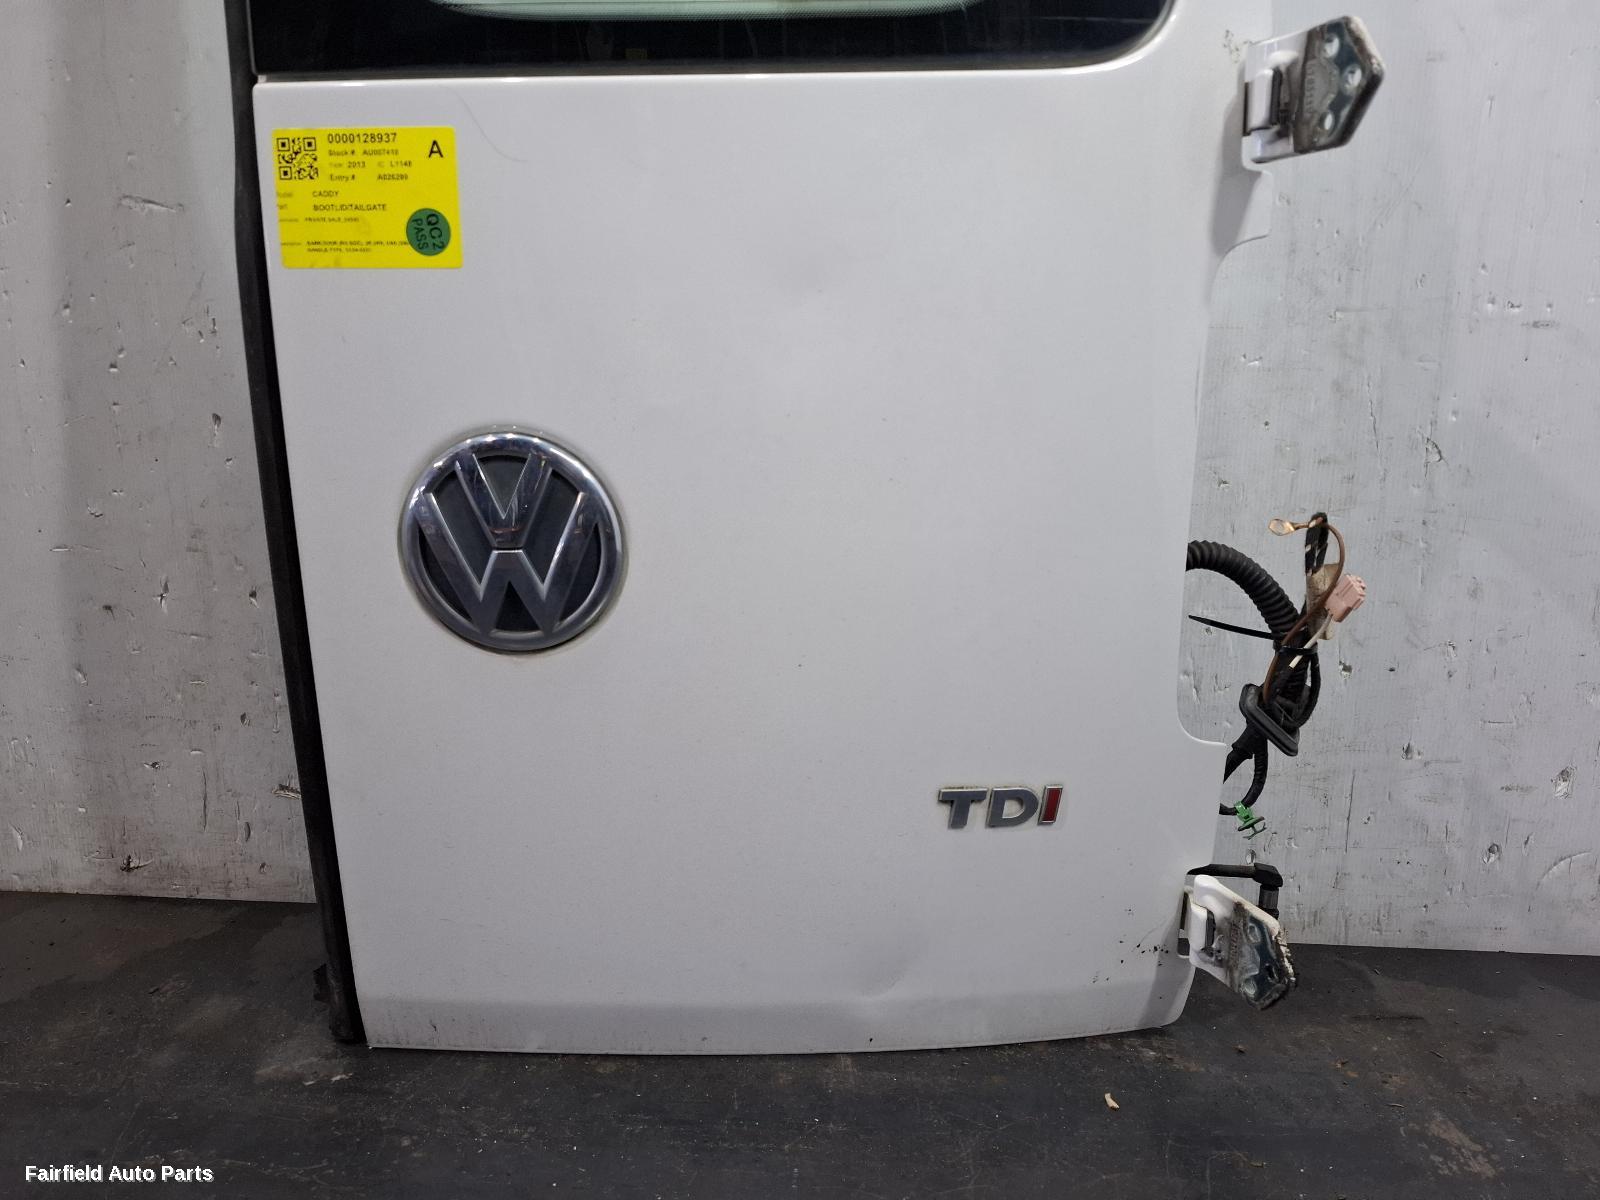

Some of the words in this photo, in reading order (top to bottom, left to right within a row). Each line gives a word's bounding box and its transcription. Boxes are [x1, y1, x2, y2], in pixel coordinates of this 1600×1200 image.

[327, 132, 397, 144] 0000128937
[428, 139, 444, 158] A
[312, 190, 339, 198] CADDY
[411, 218, 429, 250] PASS
[938, 786, 1063, 829] TDI
